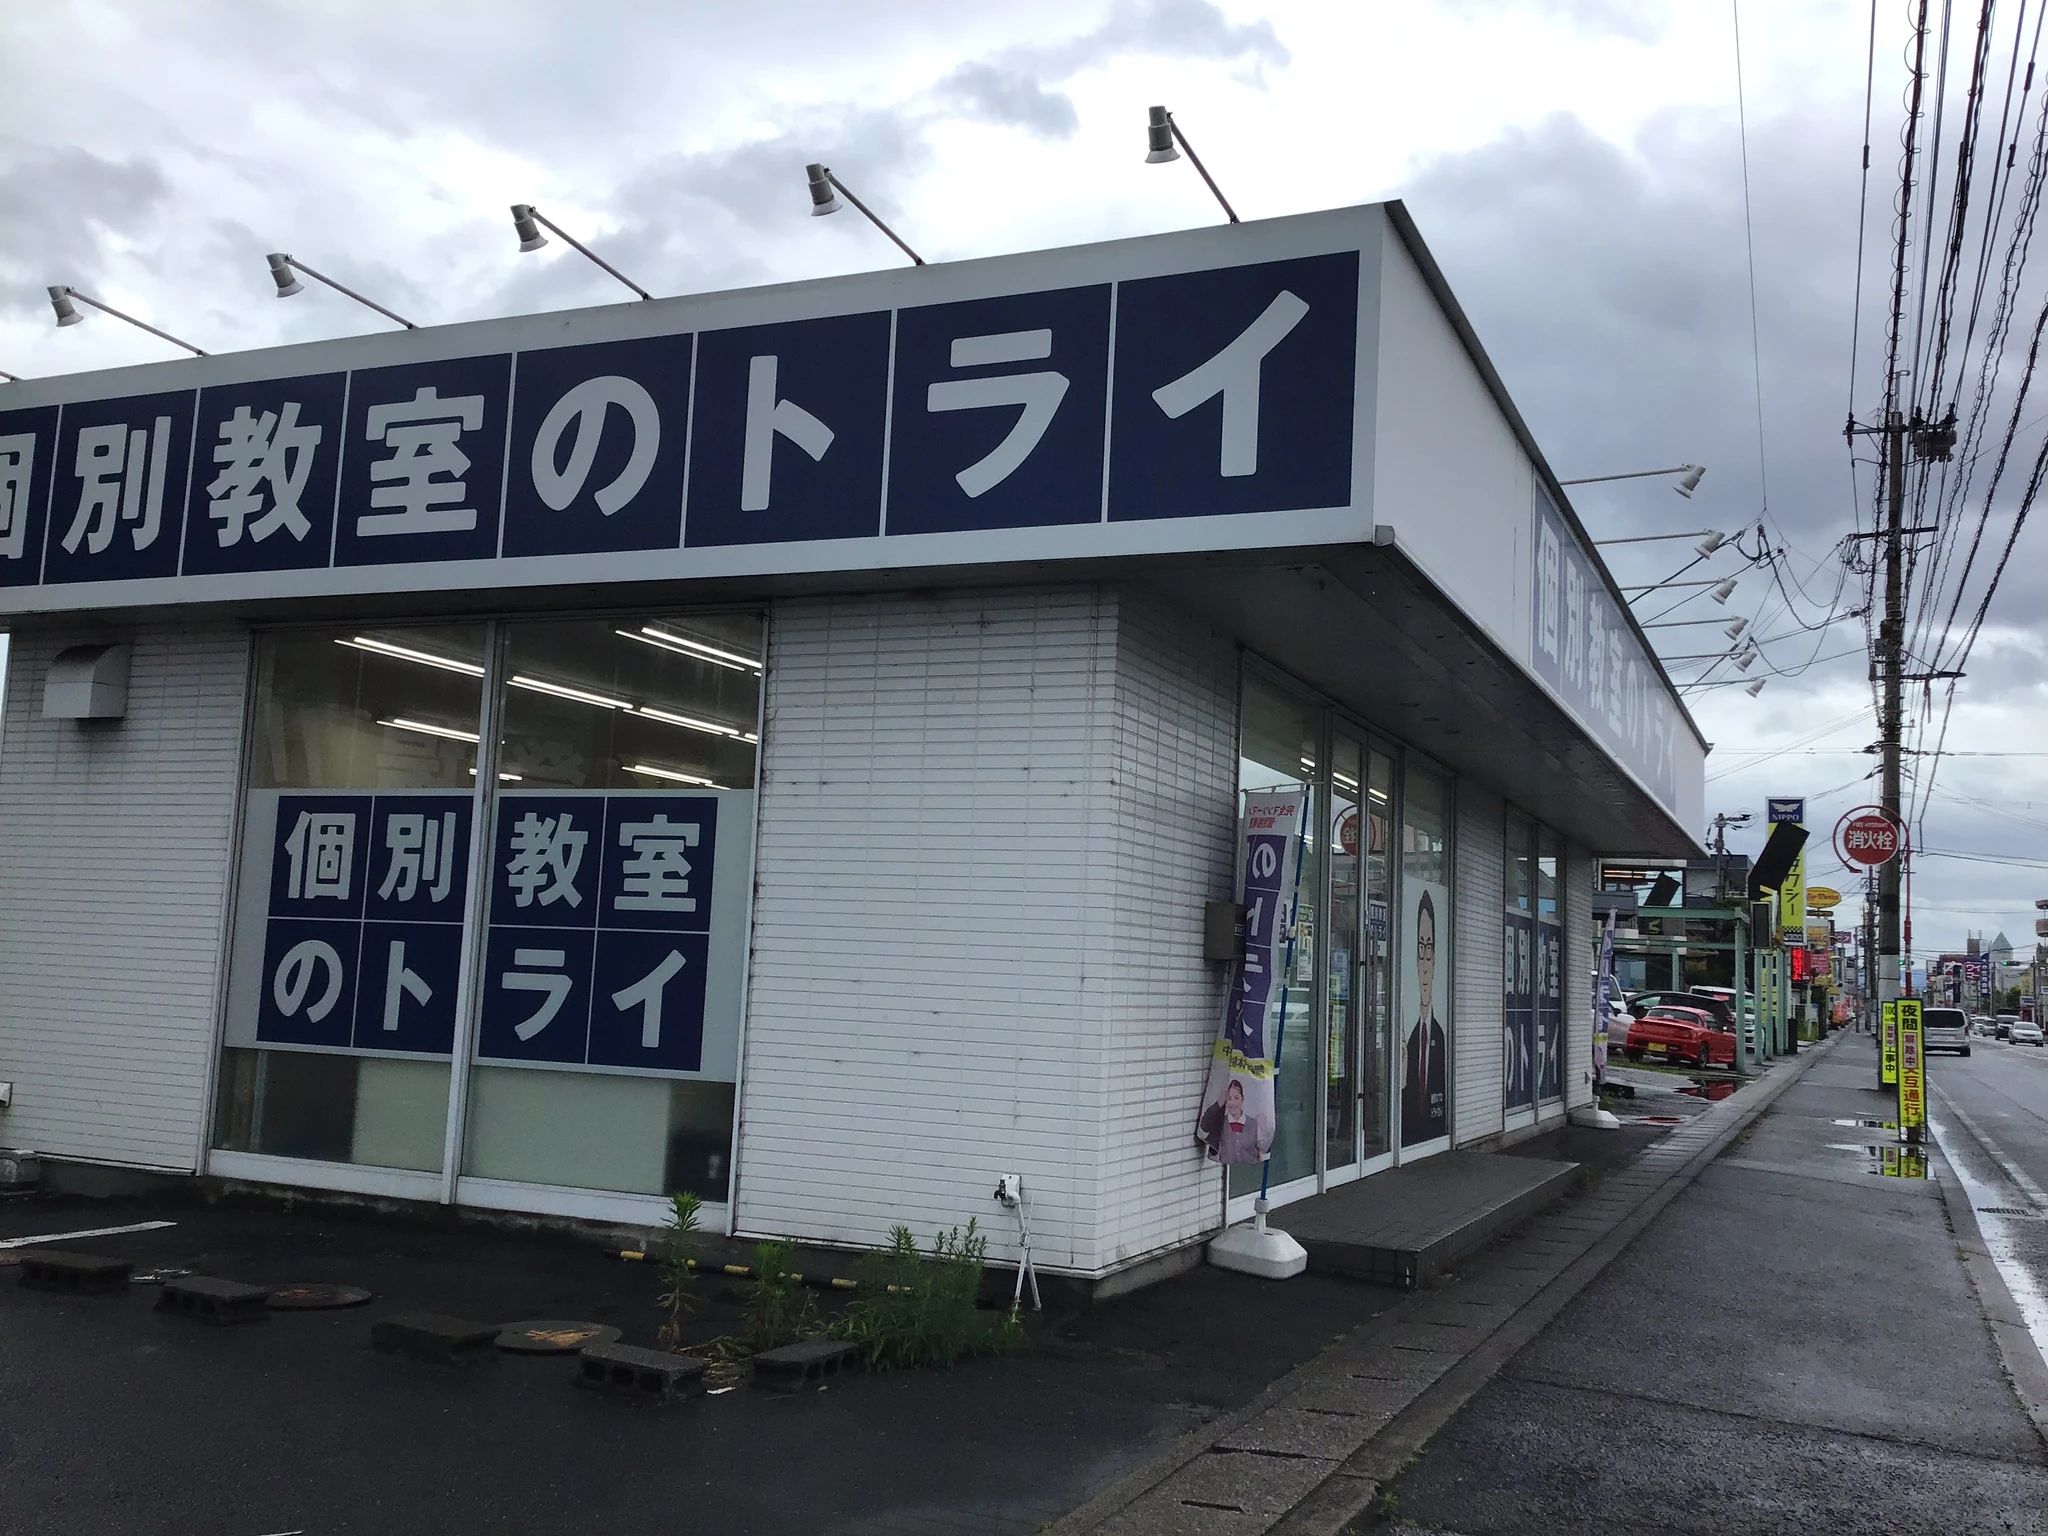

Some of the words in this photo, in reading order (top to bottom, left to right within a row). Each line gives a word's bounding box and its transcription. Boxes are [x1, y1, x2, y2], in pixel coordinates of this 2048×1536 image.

[284, 810, 700, 912] 個別教室
[1848, 830, 1894, 851] 消火栓
[273, 938, 686, 1048] のトライ
[1901, 1004, 1918, 1031] 夜間
